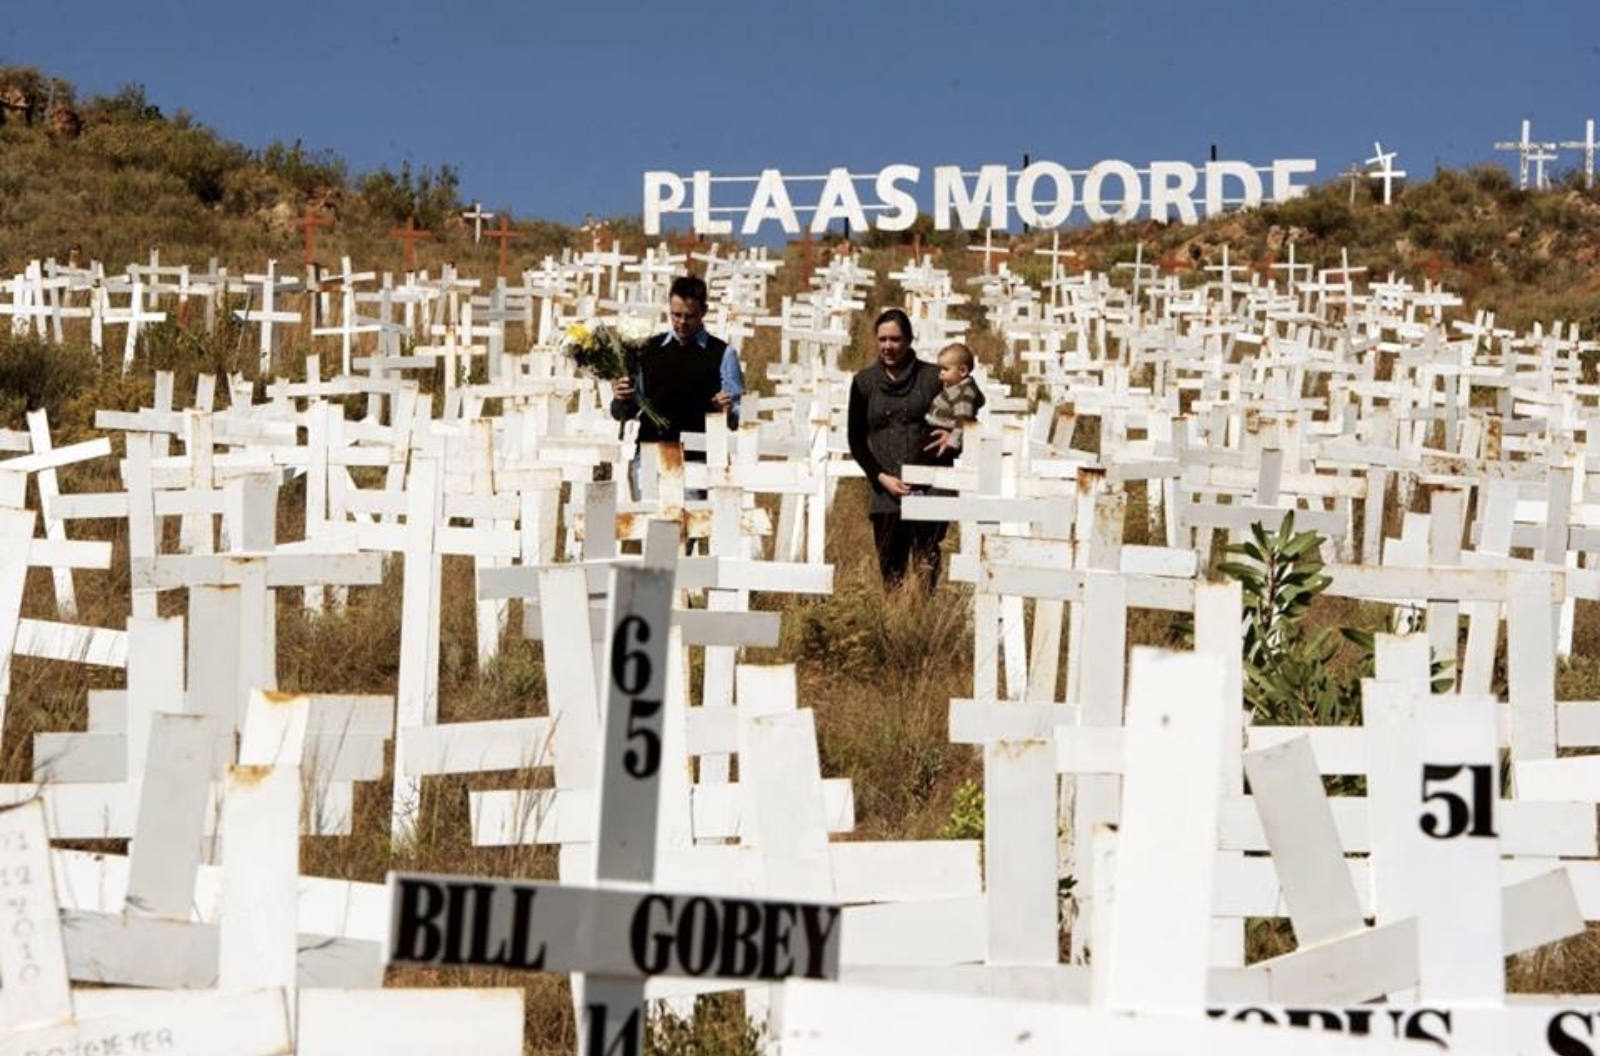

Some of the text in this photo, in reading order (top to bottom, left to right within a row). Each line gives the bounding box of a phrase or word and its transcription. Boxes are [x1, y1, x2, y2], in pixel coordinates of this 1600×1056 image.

[643, 158, 1317, 235] PLAASMOORDE
[611, 614, 662, 780] 65
[1419, 763, 1499, 839] 51
[393, 880, 841, 980] BILL GOBEY
